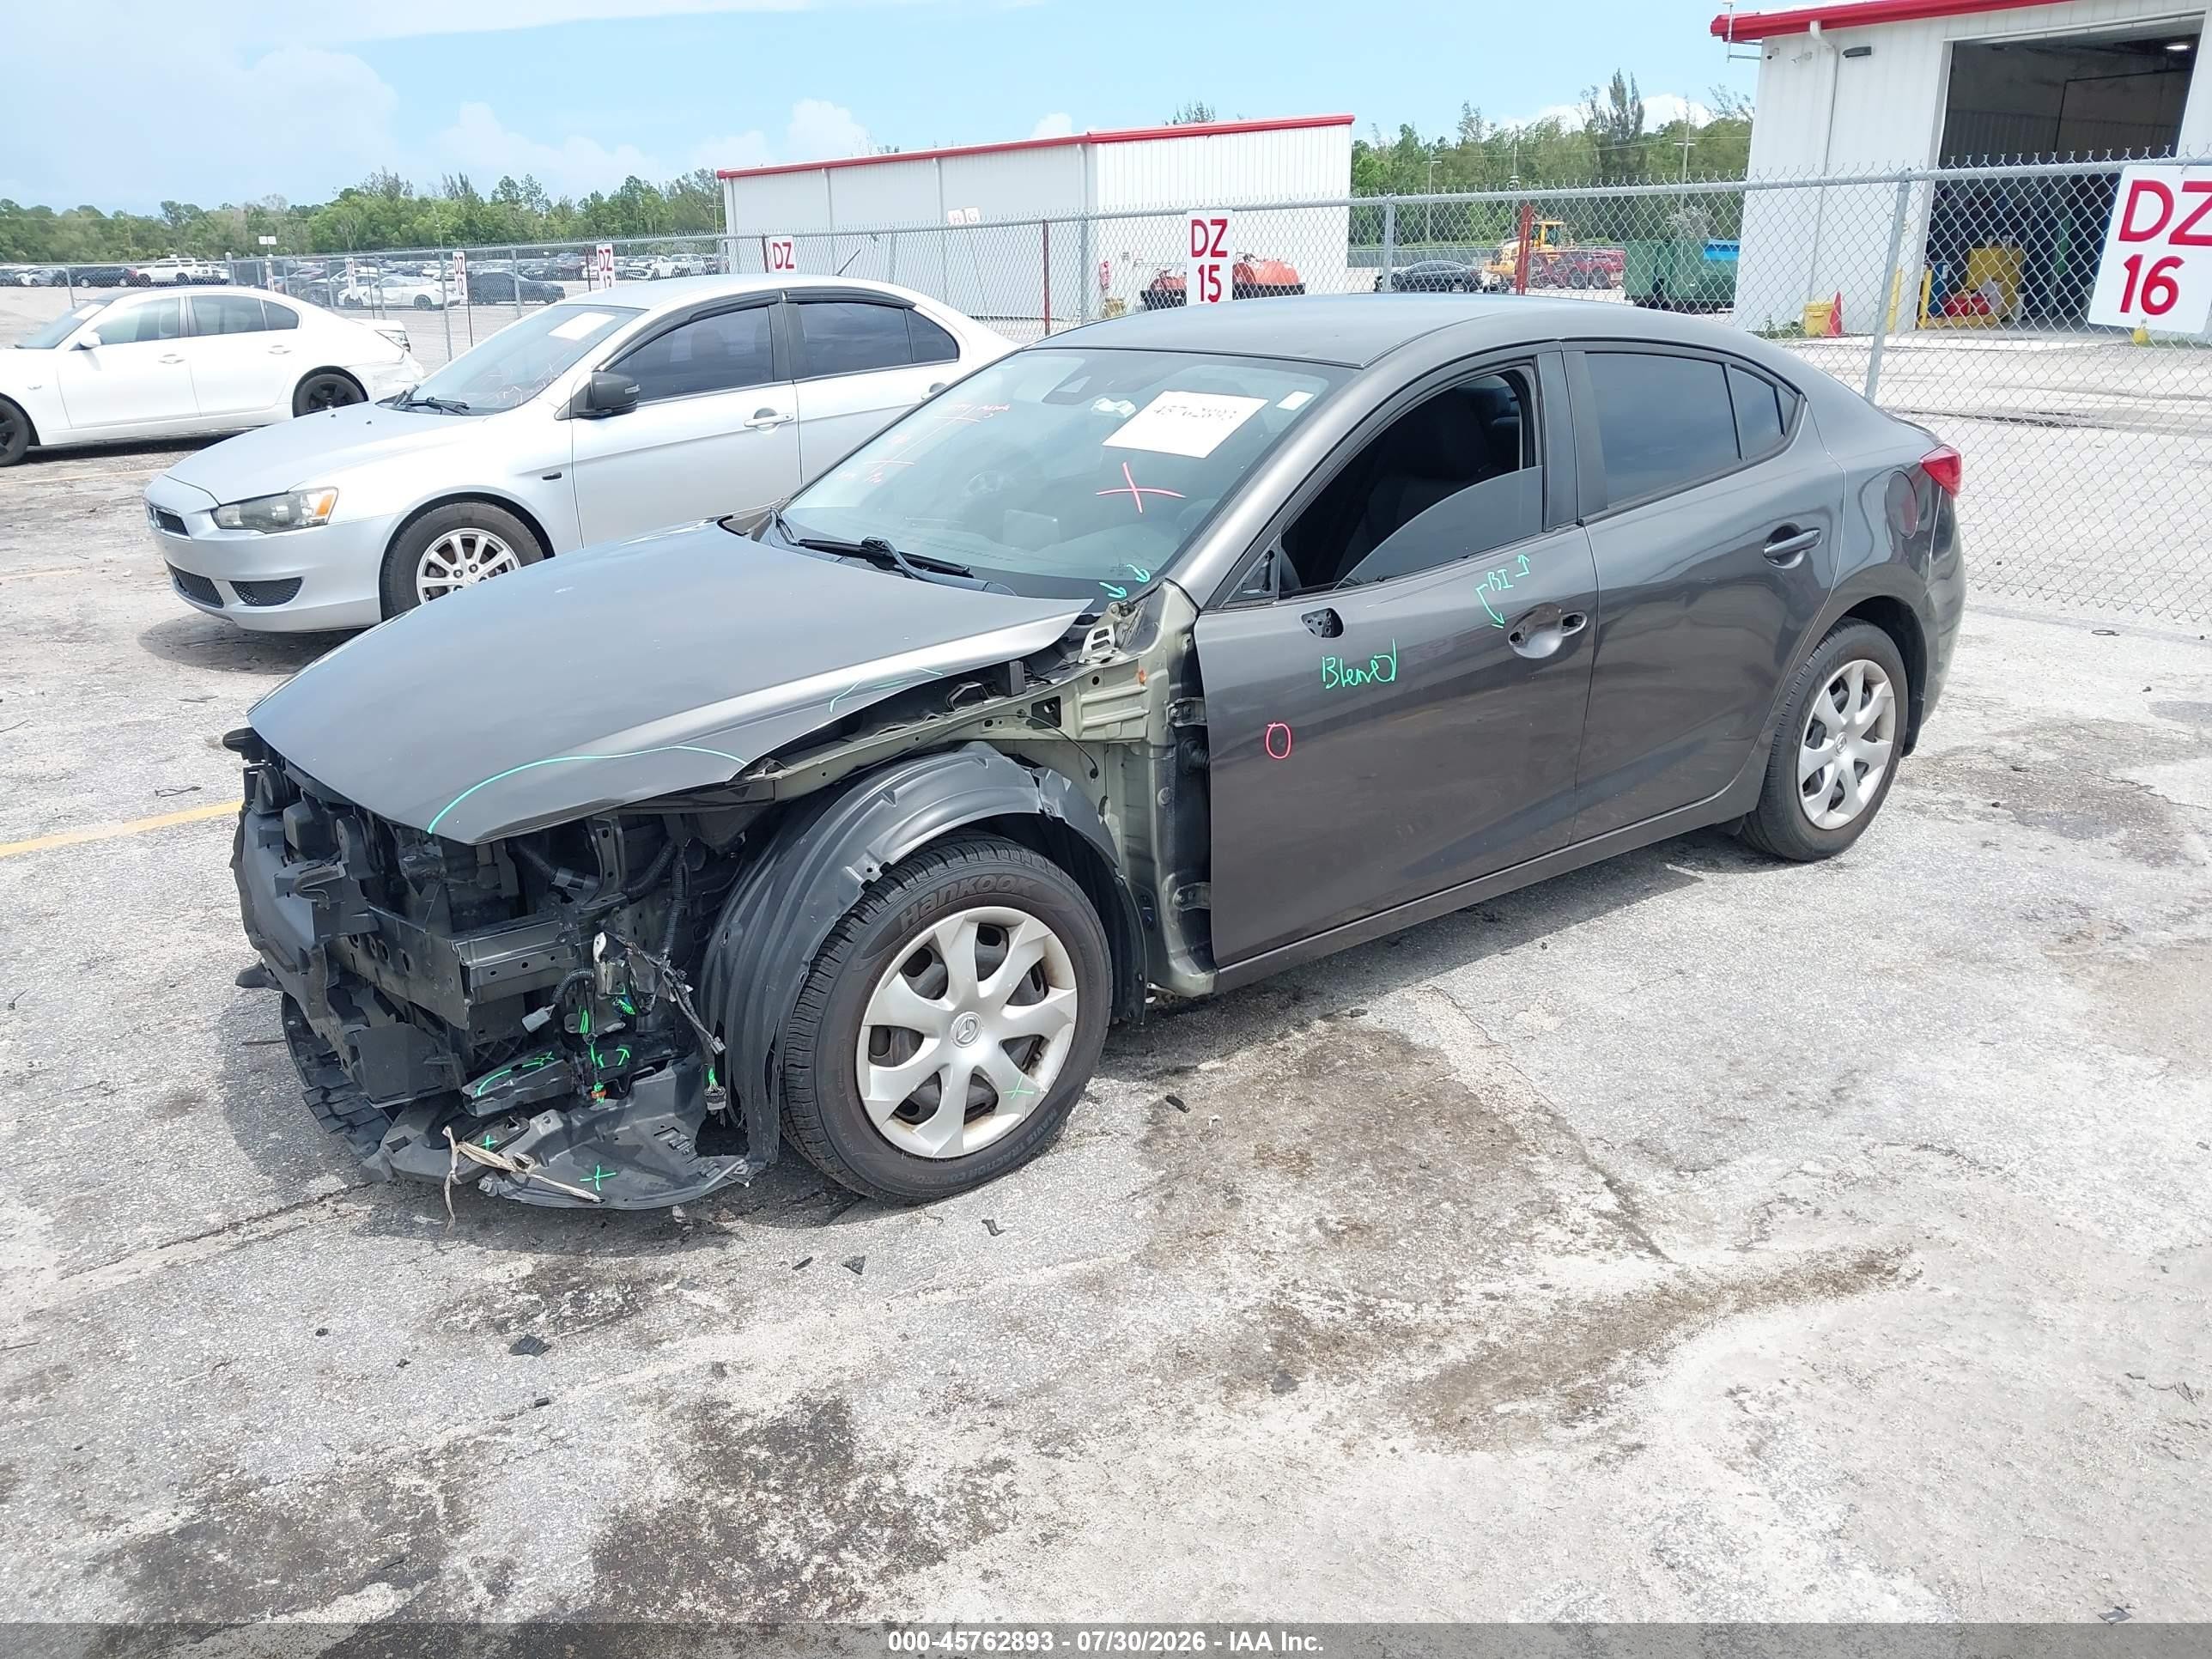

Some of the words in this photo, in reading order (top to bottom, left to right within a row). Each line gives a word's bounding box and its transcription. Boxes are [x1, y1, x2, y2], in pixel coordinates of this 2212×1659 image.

[2118, 179, 2212, 246] DZ
[772, 241, 795, 270] DZ
[1191, 218, 1228, 258] DZ
[453, 256, 465, 276] DZ
[598, 248, 613, 272] DZ
[1197, 264, 1223, 303] 15
[2119, 253, 2185, 316] 16
